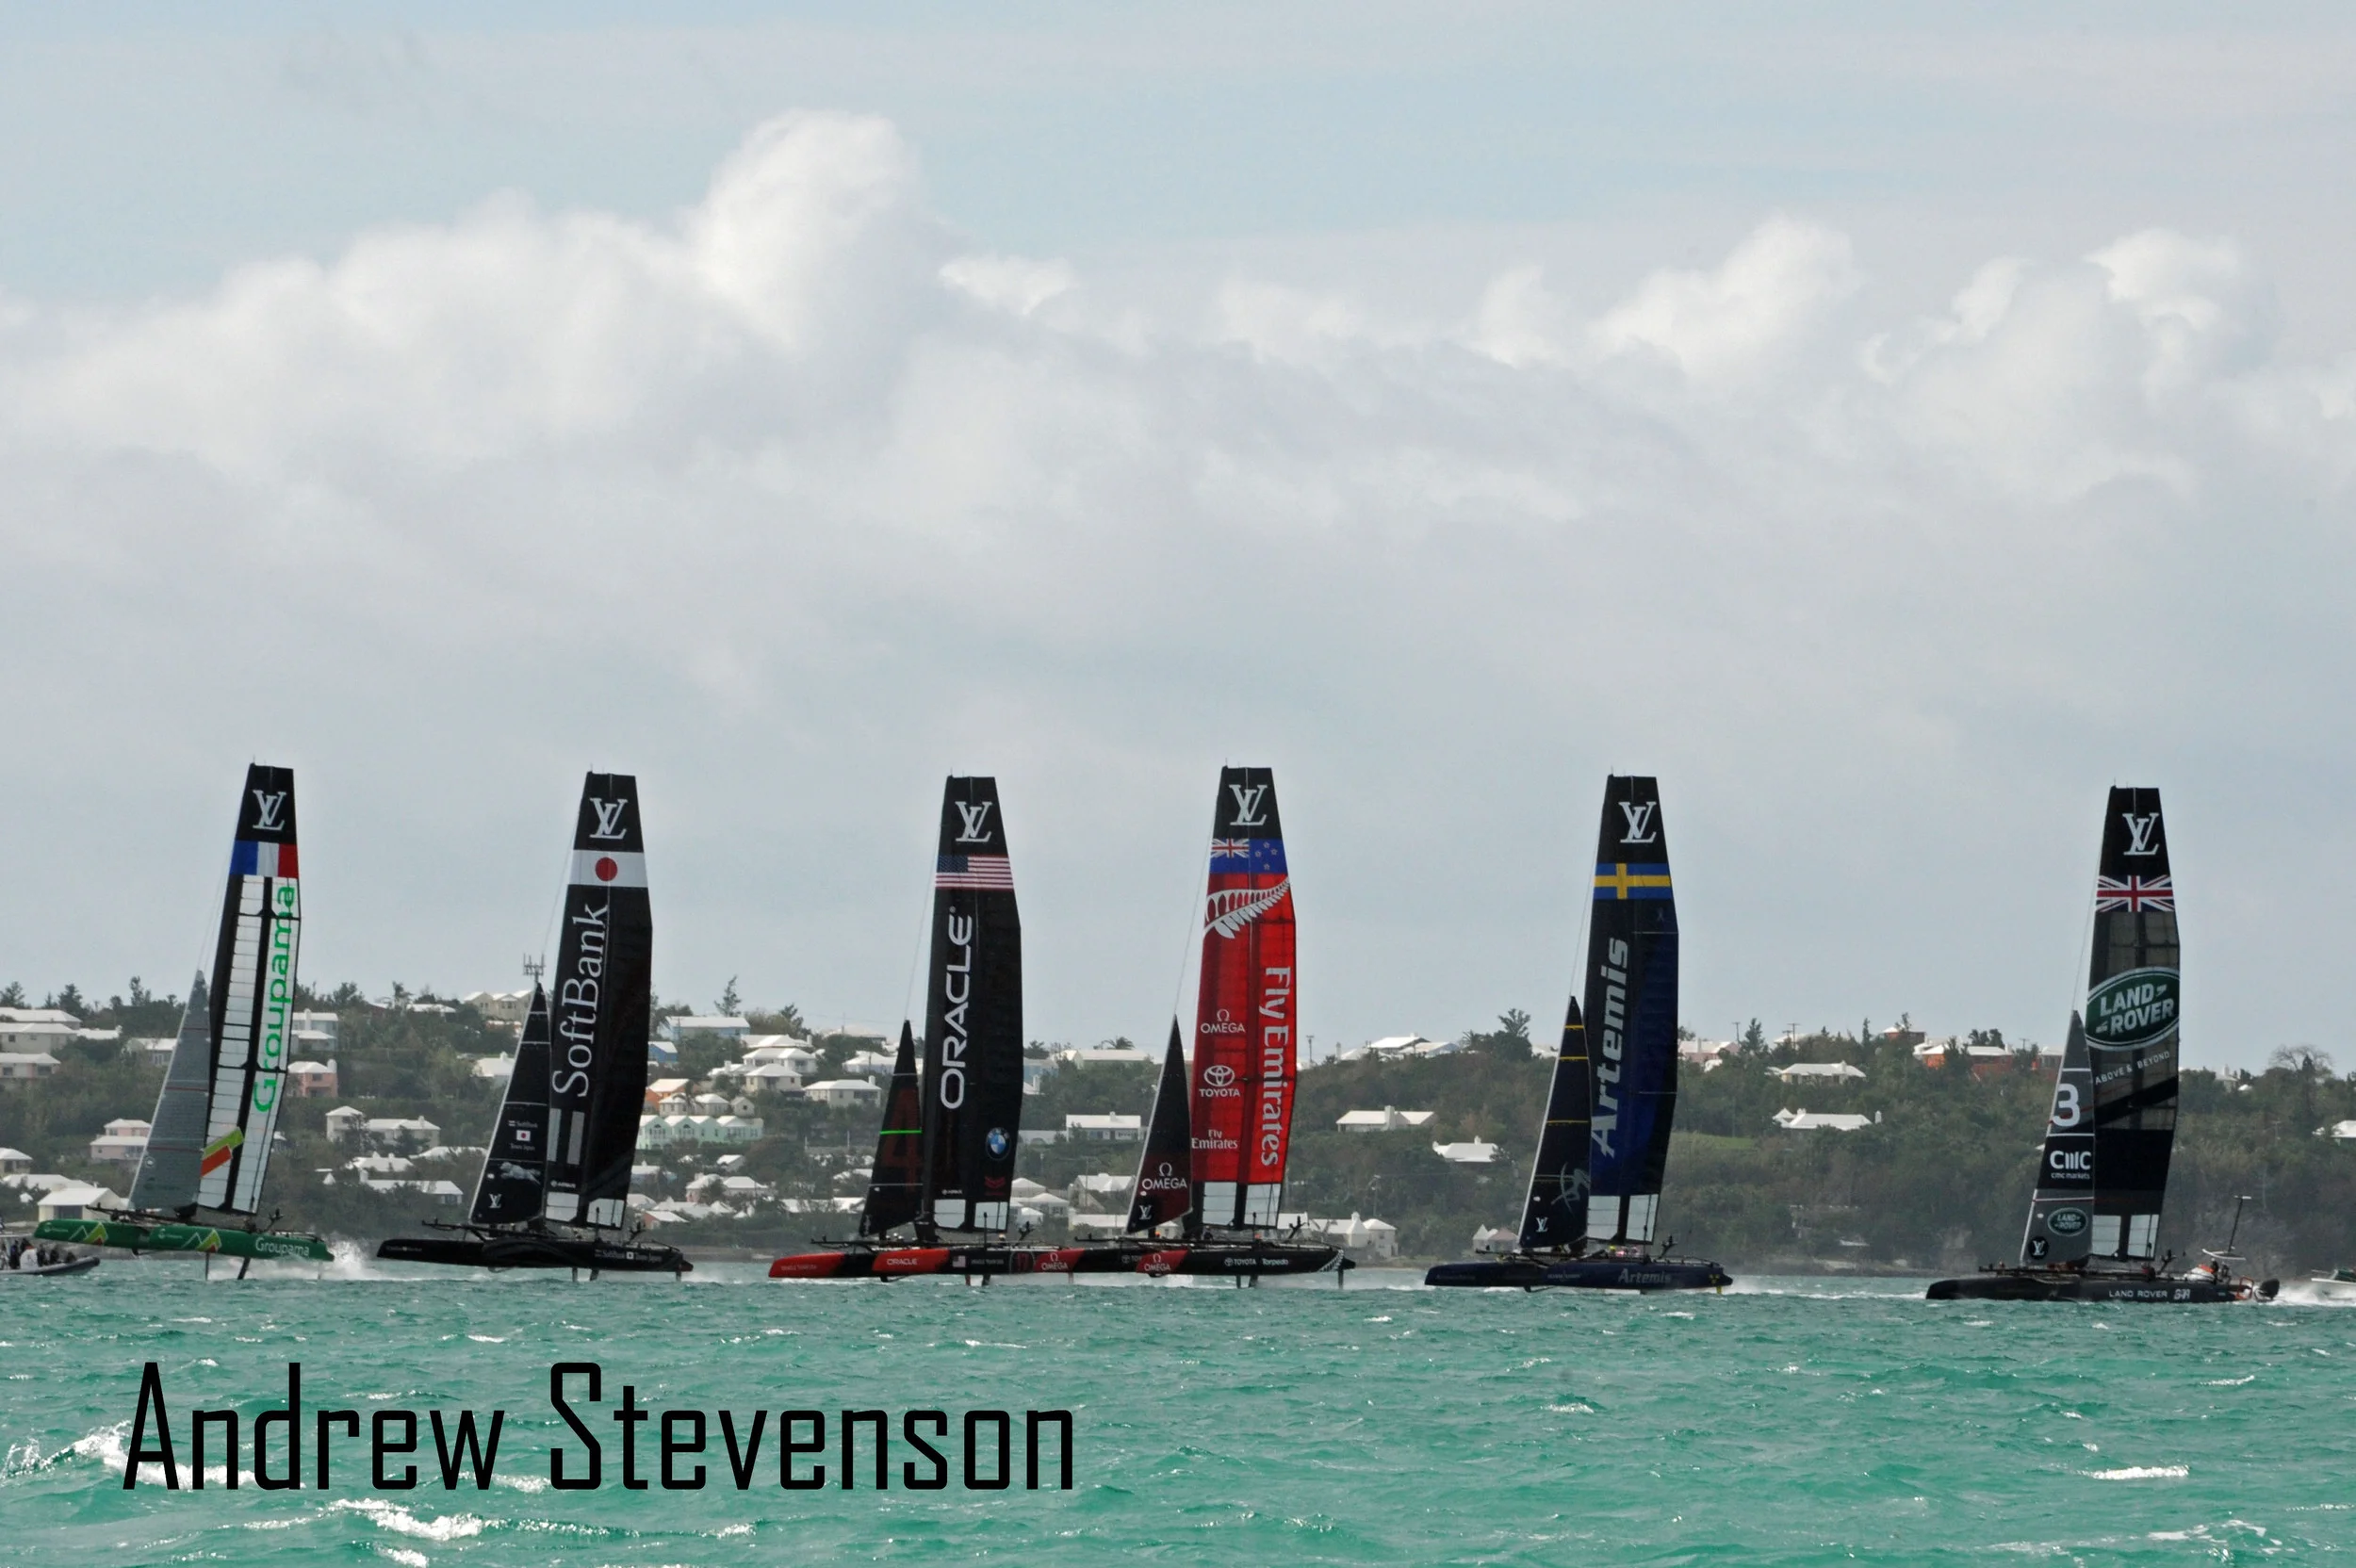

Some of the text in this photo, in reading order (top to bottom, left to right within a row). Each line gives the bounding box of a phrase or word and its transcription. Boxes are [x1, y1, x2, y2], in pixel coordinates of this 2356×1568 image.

[253, 885, 295, 1113] Groupama
[552, 904, 608, 1097] SoftBank
[941, 913, 973, 1109] ORACLE
[2100, 983, 2154, 1016] LAND
[1200, 1022, 1246, 1034] OMEGA
[2110, 998, 2174, 1036] ROVER
[1591, 939, 1628, 1158] Artemis
[1258, 967, 1291, 1167] Fly Emirates
[2095, 1066, 2124, 1085] ABOVE
[2136, 1050, 2170, 1070] BEYOND
[1199, 1088, 1240, 1098] TOYOTA
[2053, 1084, 2080, 1127] 3
[1191, 1136, 1238, 1150] Emirates
[1141, 1178, 1187, 1190] OMEGA
[254, 1238, 310, 1257] Groupama
[1041, 1263, 1069, 1271] OMEGA
[1143, 1263, 1170, 1272] OMEGA
[1618, 1267, 1672, 1284] Artemis
[2108, 1289, 2168, 1298] LAND ROVER
